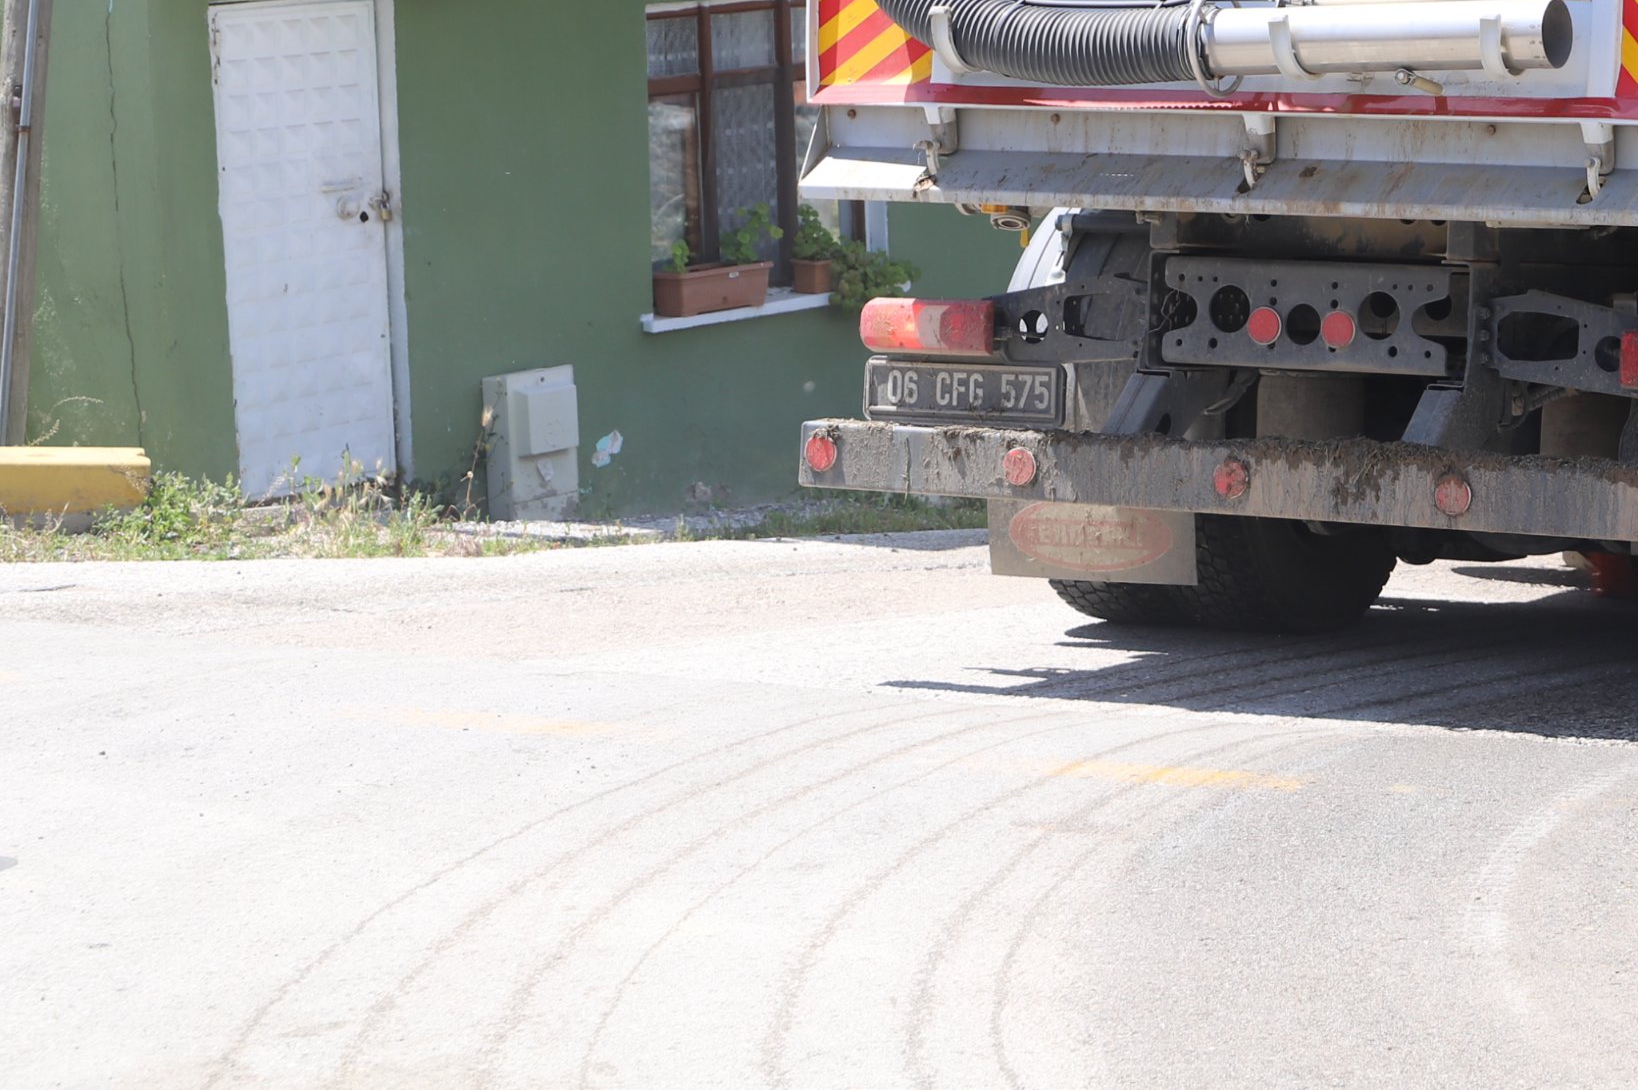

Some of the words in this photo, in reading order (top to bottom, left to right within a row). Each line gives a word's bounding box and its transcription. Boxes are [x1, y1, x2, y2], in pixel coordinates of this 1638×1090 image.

[886, 369, 919, 405] 06
[935, 371, 985, 407] CFG
[999, 373, 1050, 410] 575
